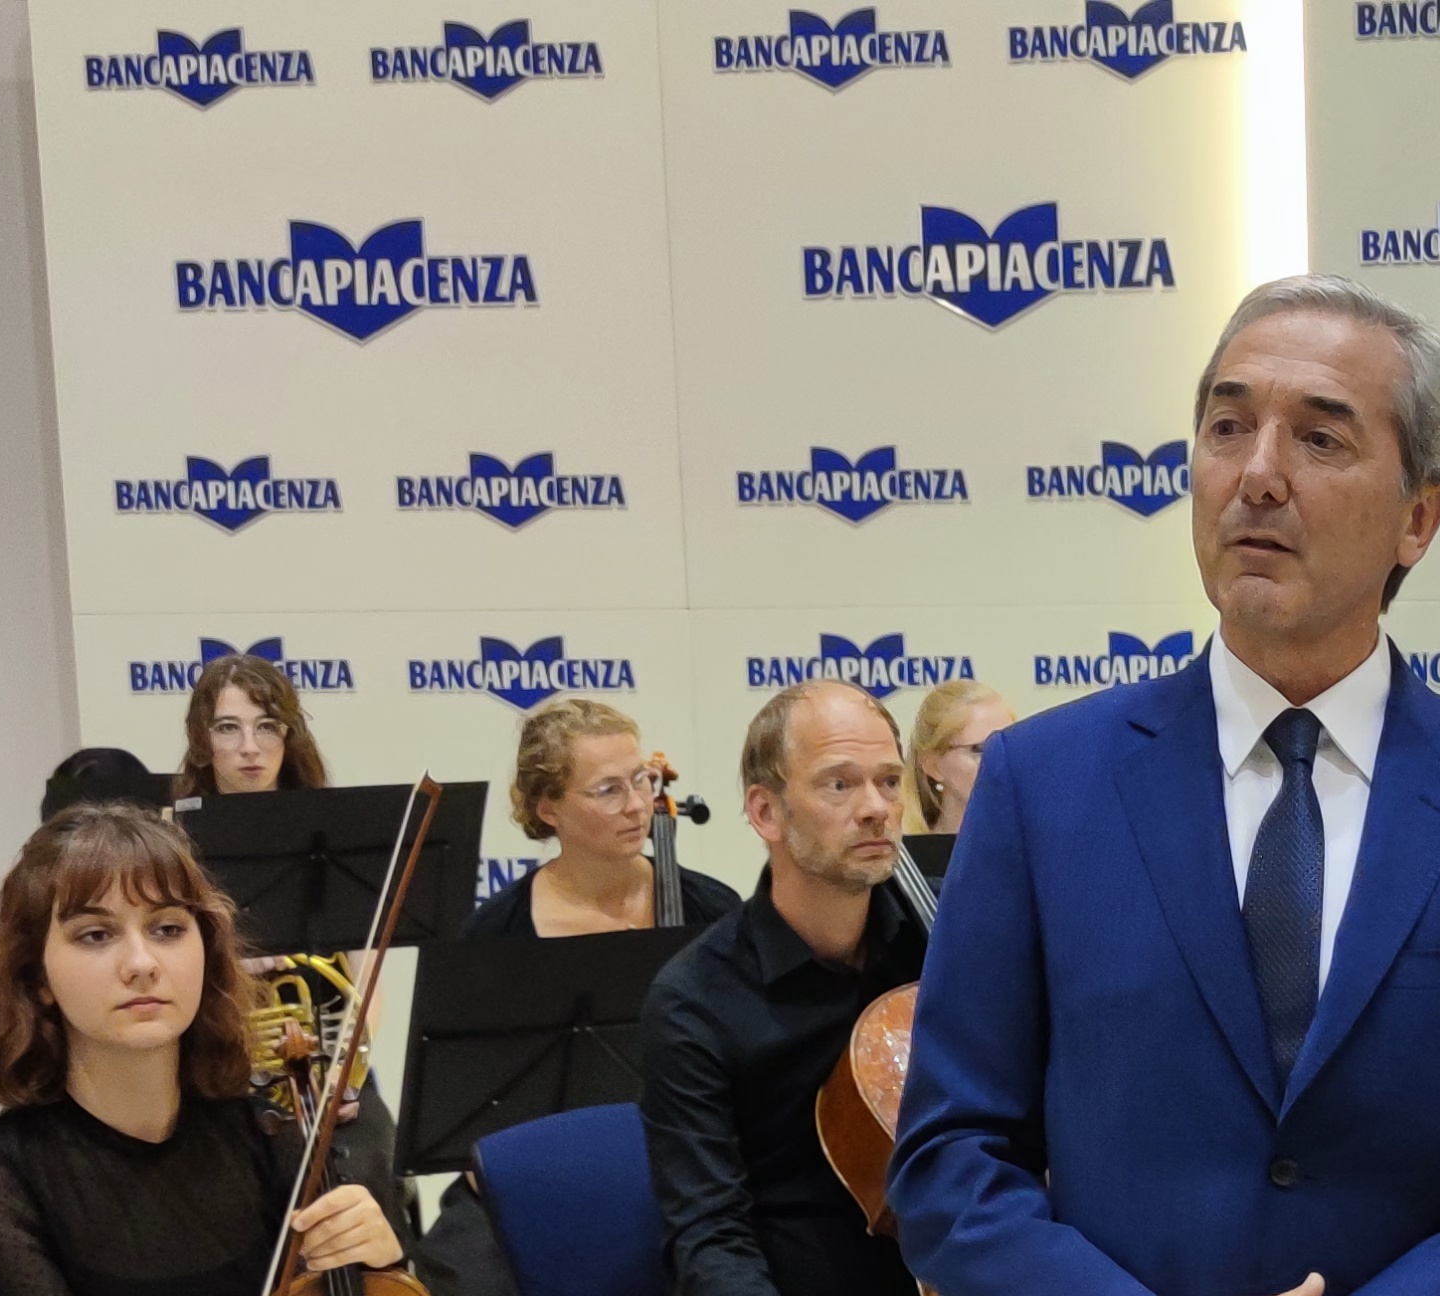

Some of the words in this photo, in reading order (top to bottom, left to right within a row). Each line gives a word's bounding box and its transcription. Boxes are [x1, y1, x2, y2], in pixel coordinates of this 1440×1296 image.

[715, 31, 950, 69] BANCAPIACENZA
[1009, 22, 1247, 61] BANCAPIACENZA
[85, 51, 313, 87] BANCAPIACENZA
[371, 43, 602, 79] BANCAPIACENZA
[175, 256, 537, 307] BANCAPIACENZA
[803, 238, 1175, 296] BANCAPIACENZA
[115, 480, 340, 510] BANCAPIACENZA
[397, 476, 624, 507] BANCAPIACENZA
[738, 469, 967, 502] BANCAPIACENZA
[1027, 465, 1191, 497] BANCAPIAC
[409, 659, 634, 689] BANCAPIACENZA
